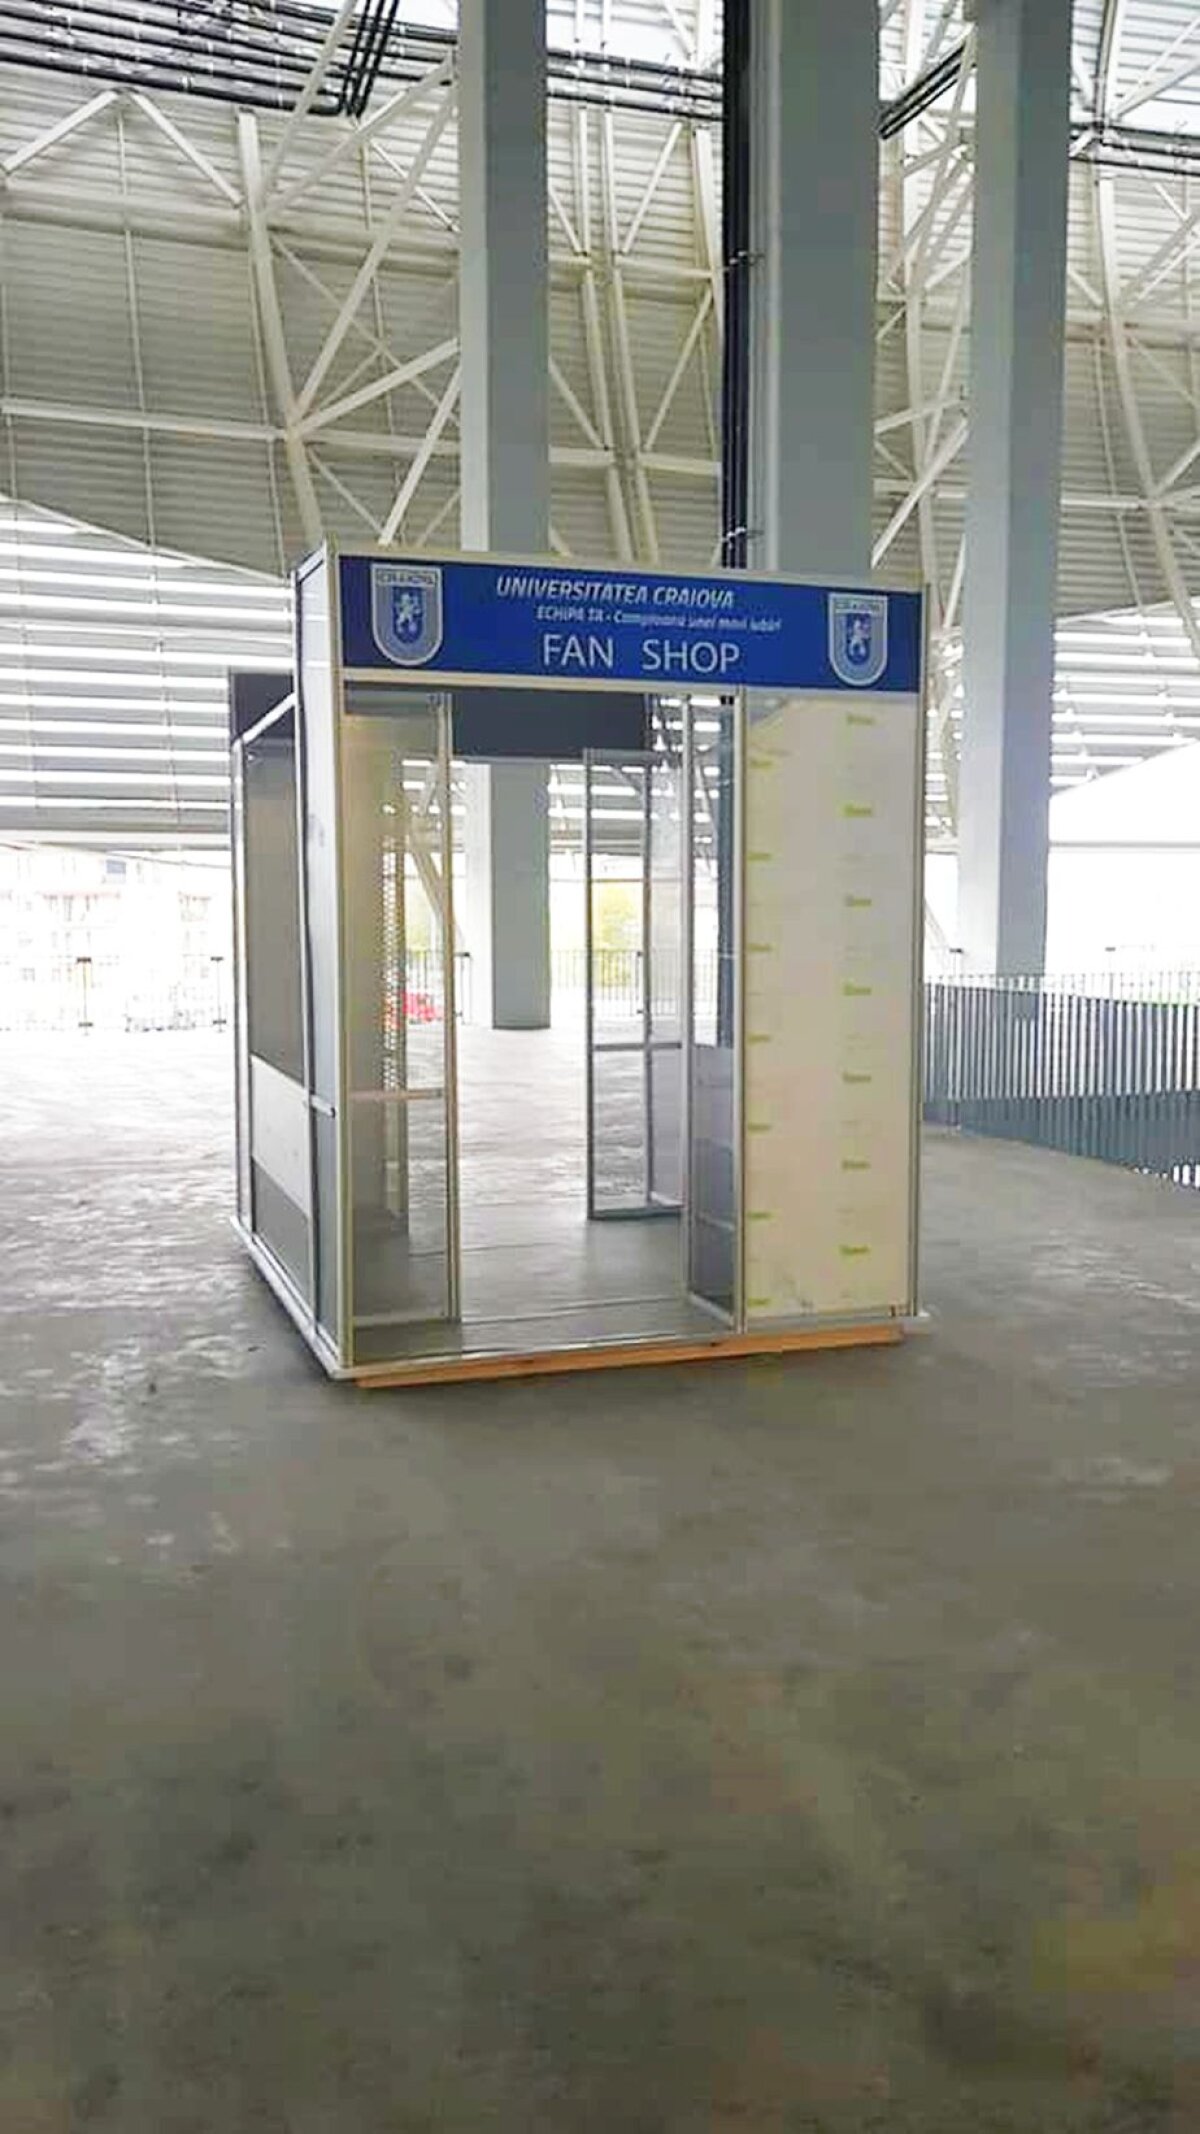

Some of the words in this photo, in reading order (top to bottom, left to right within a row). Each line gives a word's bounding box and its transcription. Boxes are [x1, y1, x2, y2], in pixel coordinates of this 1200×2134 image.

[496, 577, 648, 602] UNIVERSITATEA
[652, 585, 735, 609] CRAIOVA
[542, 633, 614, 669] FAN
[641, 638, 741, 674] SHOP
